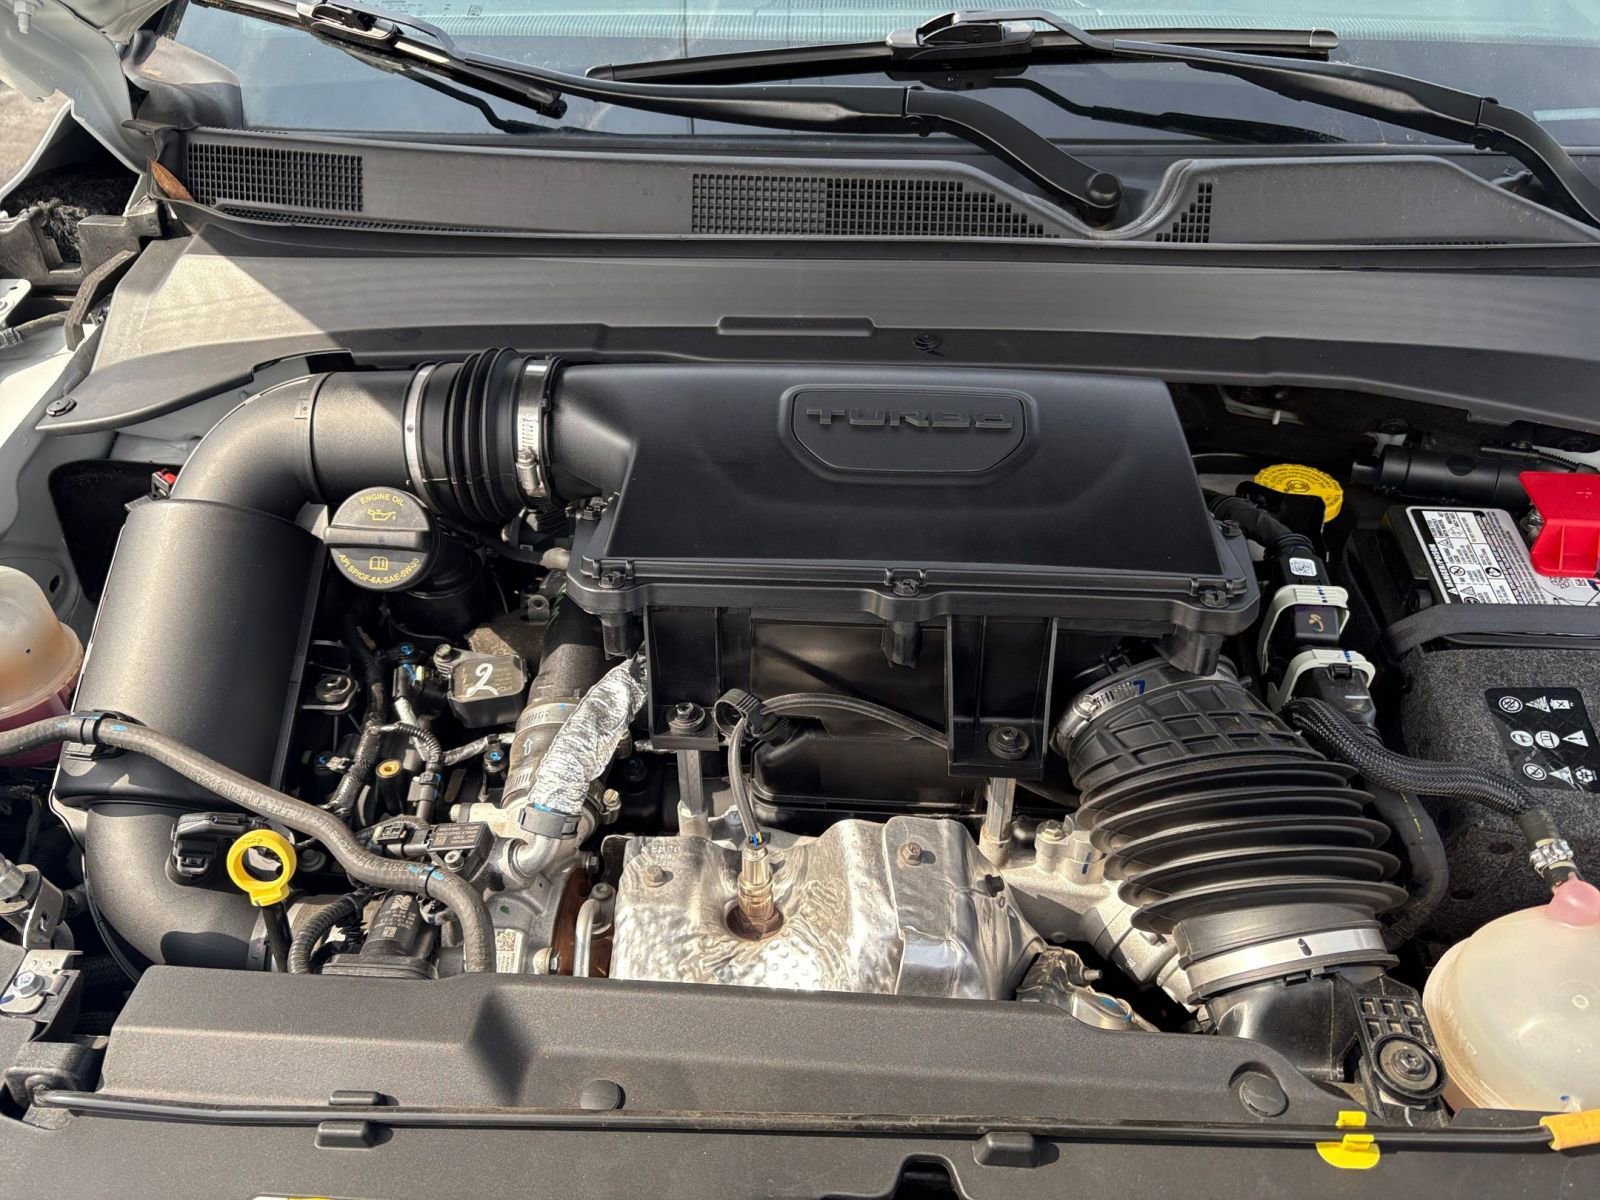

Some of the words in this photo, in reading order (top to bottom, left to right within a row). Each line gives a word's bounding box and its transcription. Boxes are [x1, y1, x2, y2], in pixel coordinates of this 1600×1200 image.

[806, 408, 1013, 429] TURBO
[360, 493, 390, 505] ENGINE
[392, 495, 404, 507] OIL
[338, 554, 349, 567] API
[466, 663, 499, 697] 2
